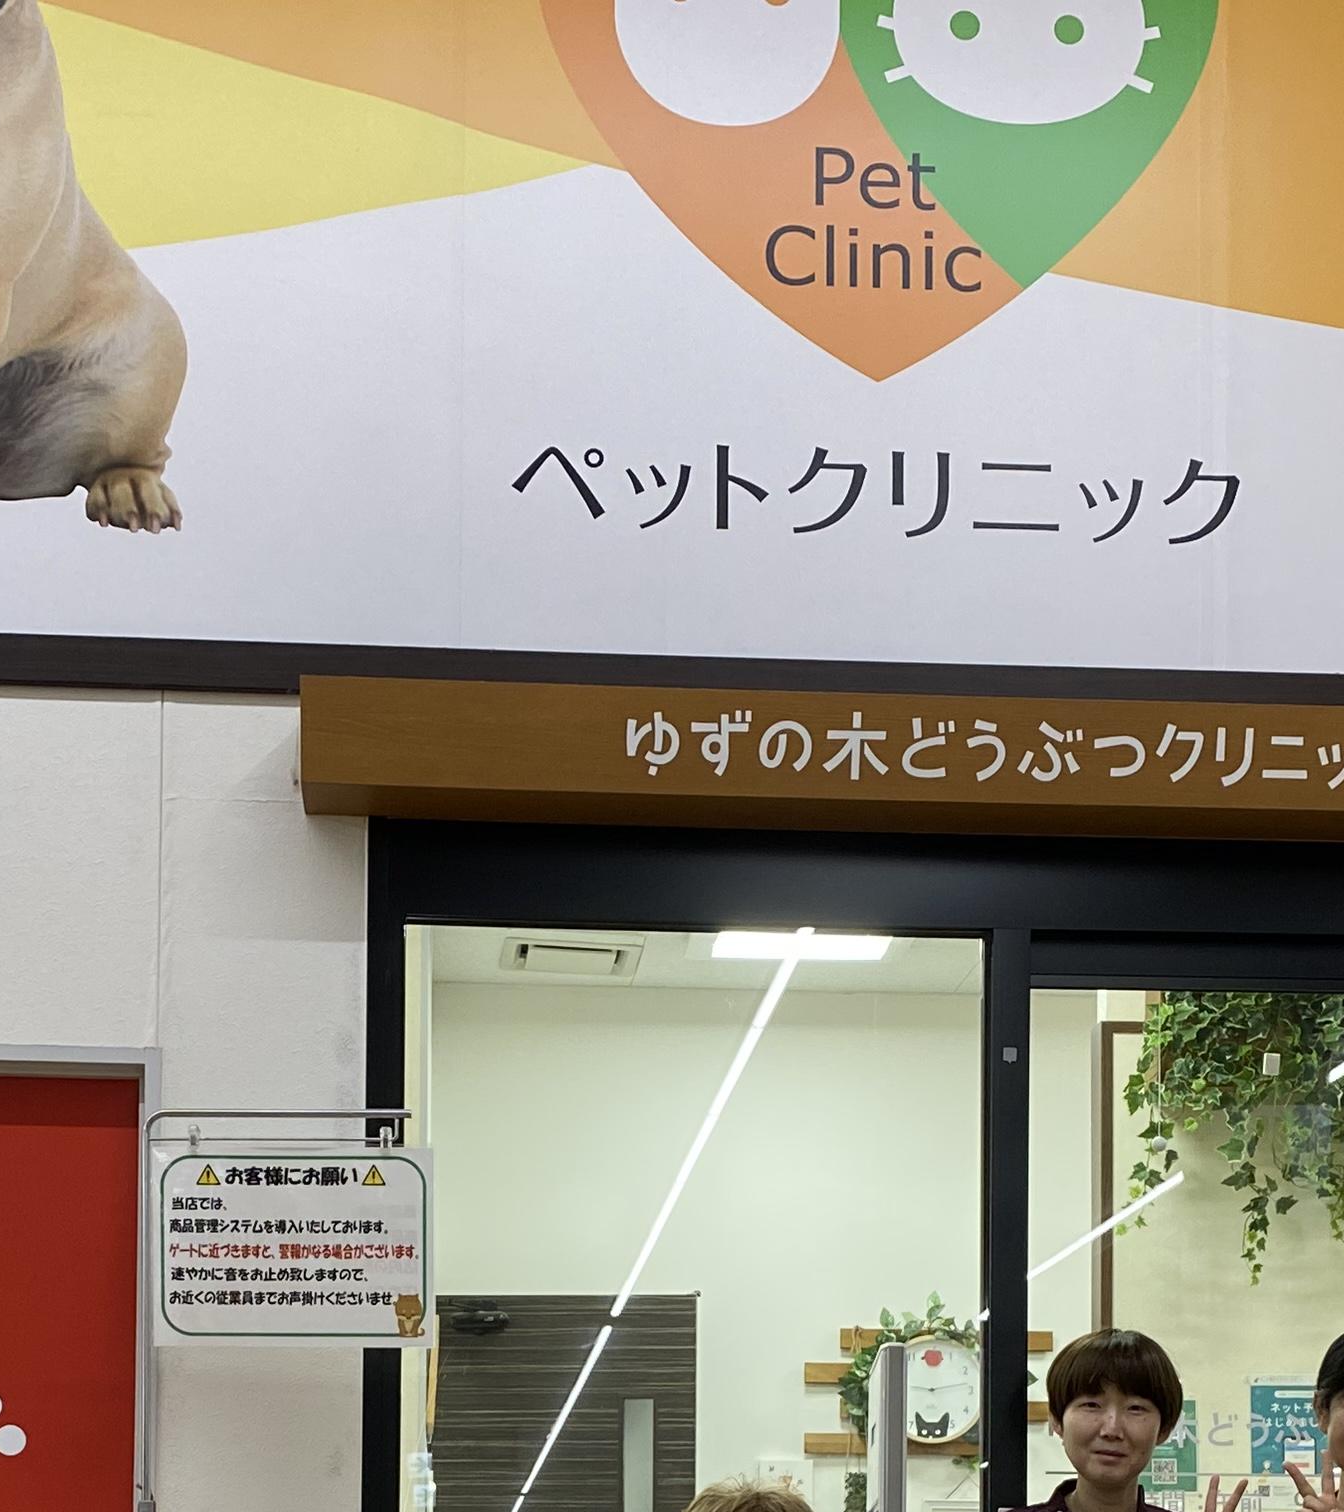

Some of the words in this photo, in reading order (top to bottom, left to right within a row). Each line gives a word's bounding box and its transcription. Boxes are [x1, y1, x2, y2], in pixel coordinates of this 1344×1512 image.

[815, 146, 936, 211] Pet
[765, 225, 983, 293] Clinic
[511, 442, 1241, 546] ペットクリニック
[224, 1166, 359, 1187] お客様にお願い
[171, 1197, 228, 1211] 当店では、
[169, 1218, 389, 1235] 商品管理システムを導入いたしております。
[170, 1267, 369, 1282] 速やかに音をお止め致しますので、
